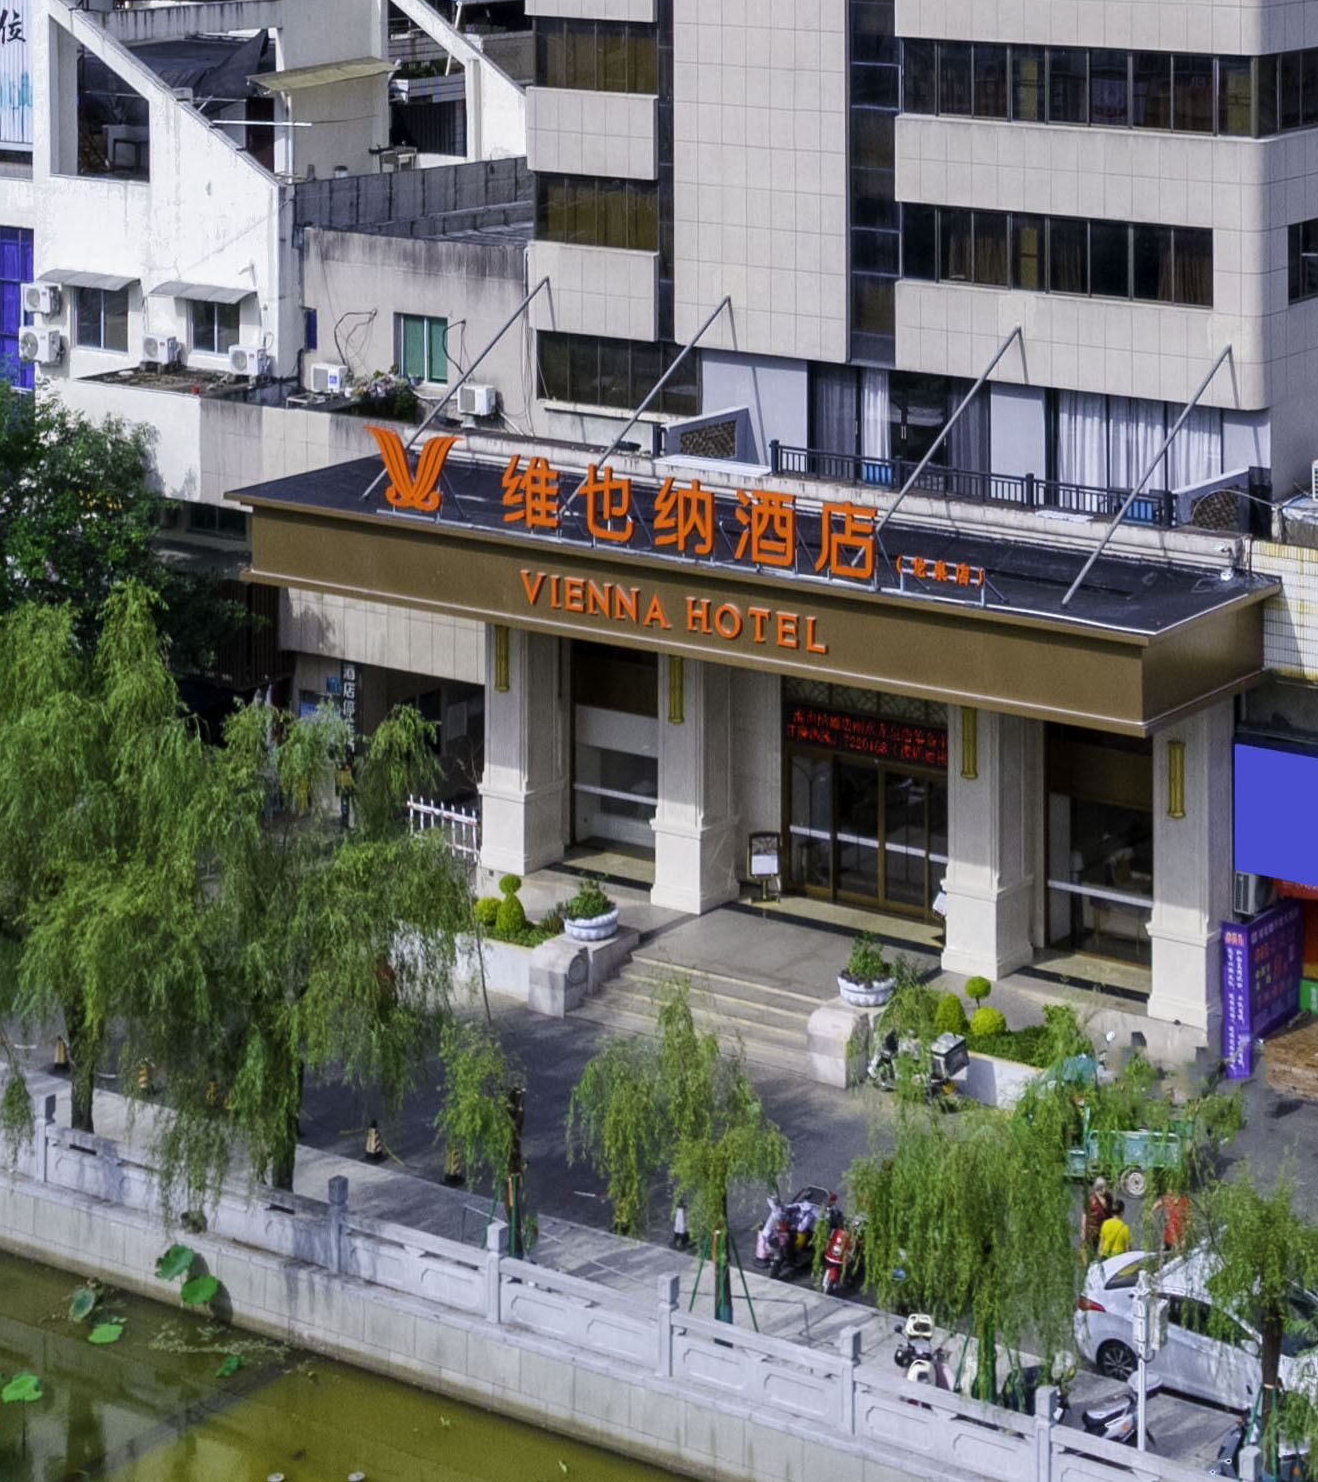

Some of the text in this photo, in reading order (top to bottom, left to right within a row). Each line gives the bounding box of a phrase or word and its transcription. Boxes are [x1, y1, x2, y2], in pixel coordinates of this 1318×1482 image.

[501, 453, 879, 580] 维也纳酒店
[520, 569, 829, 655] VIENNA HOTEL
